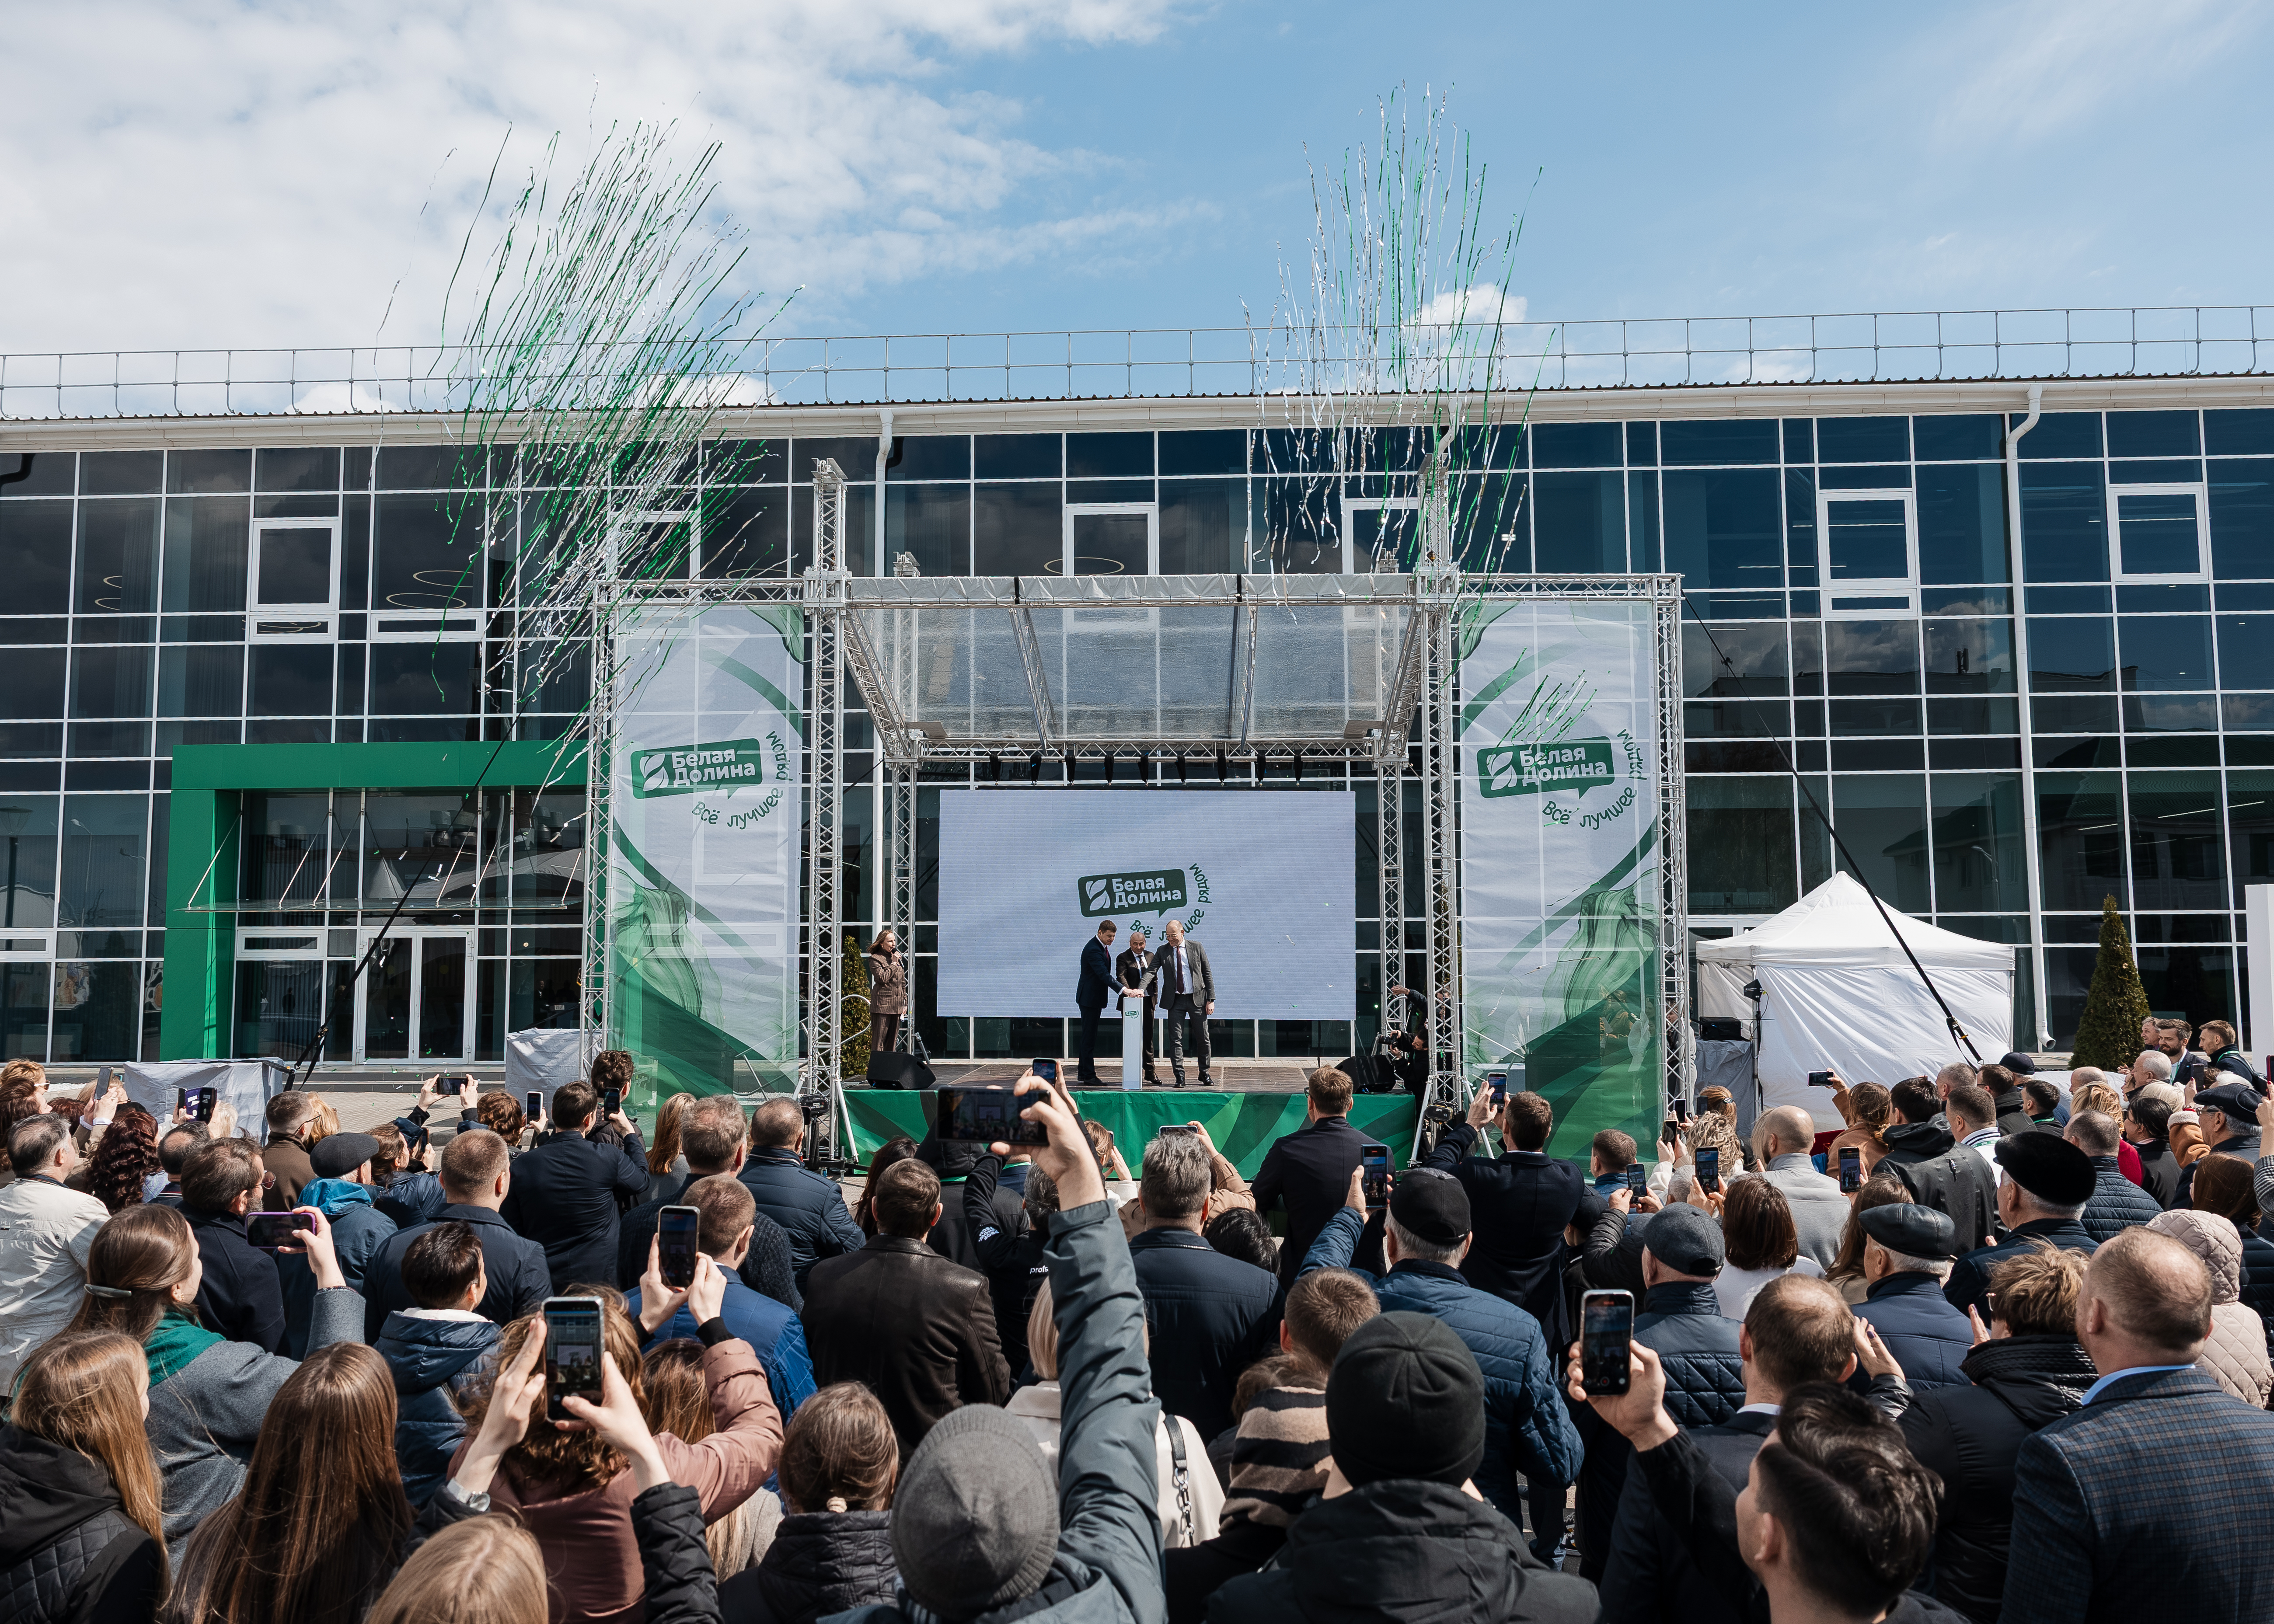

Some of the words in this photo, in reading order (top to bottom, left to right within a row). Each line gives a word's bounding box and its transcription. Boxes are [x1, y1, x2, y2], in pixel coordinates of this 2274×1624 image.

[672, 749, 736, 768] Белая
[1519, 747, 1586, 767] Белая
[673, 763, 756, 787] Долина
[691, 801, 720, 825] Всё
[727, 788, 784, 829] лучшее
[765, 731, 793, 781] рядом
[1522, 761, 1607, 787] Долина
[1542, 801, 1572, 825] Всё
[1580, 787, 1637, 829] лучшее
[1617, 728, 1647, 780] рядом
[1112, 878, 1165, 892] Белая
[1114, 889, 1182, 908] Долина
[1130, 920, 1153, 939] Всё
[1159, 909, 1204, 941] лшее
[1189, 863, 1213, 904] рядом
